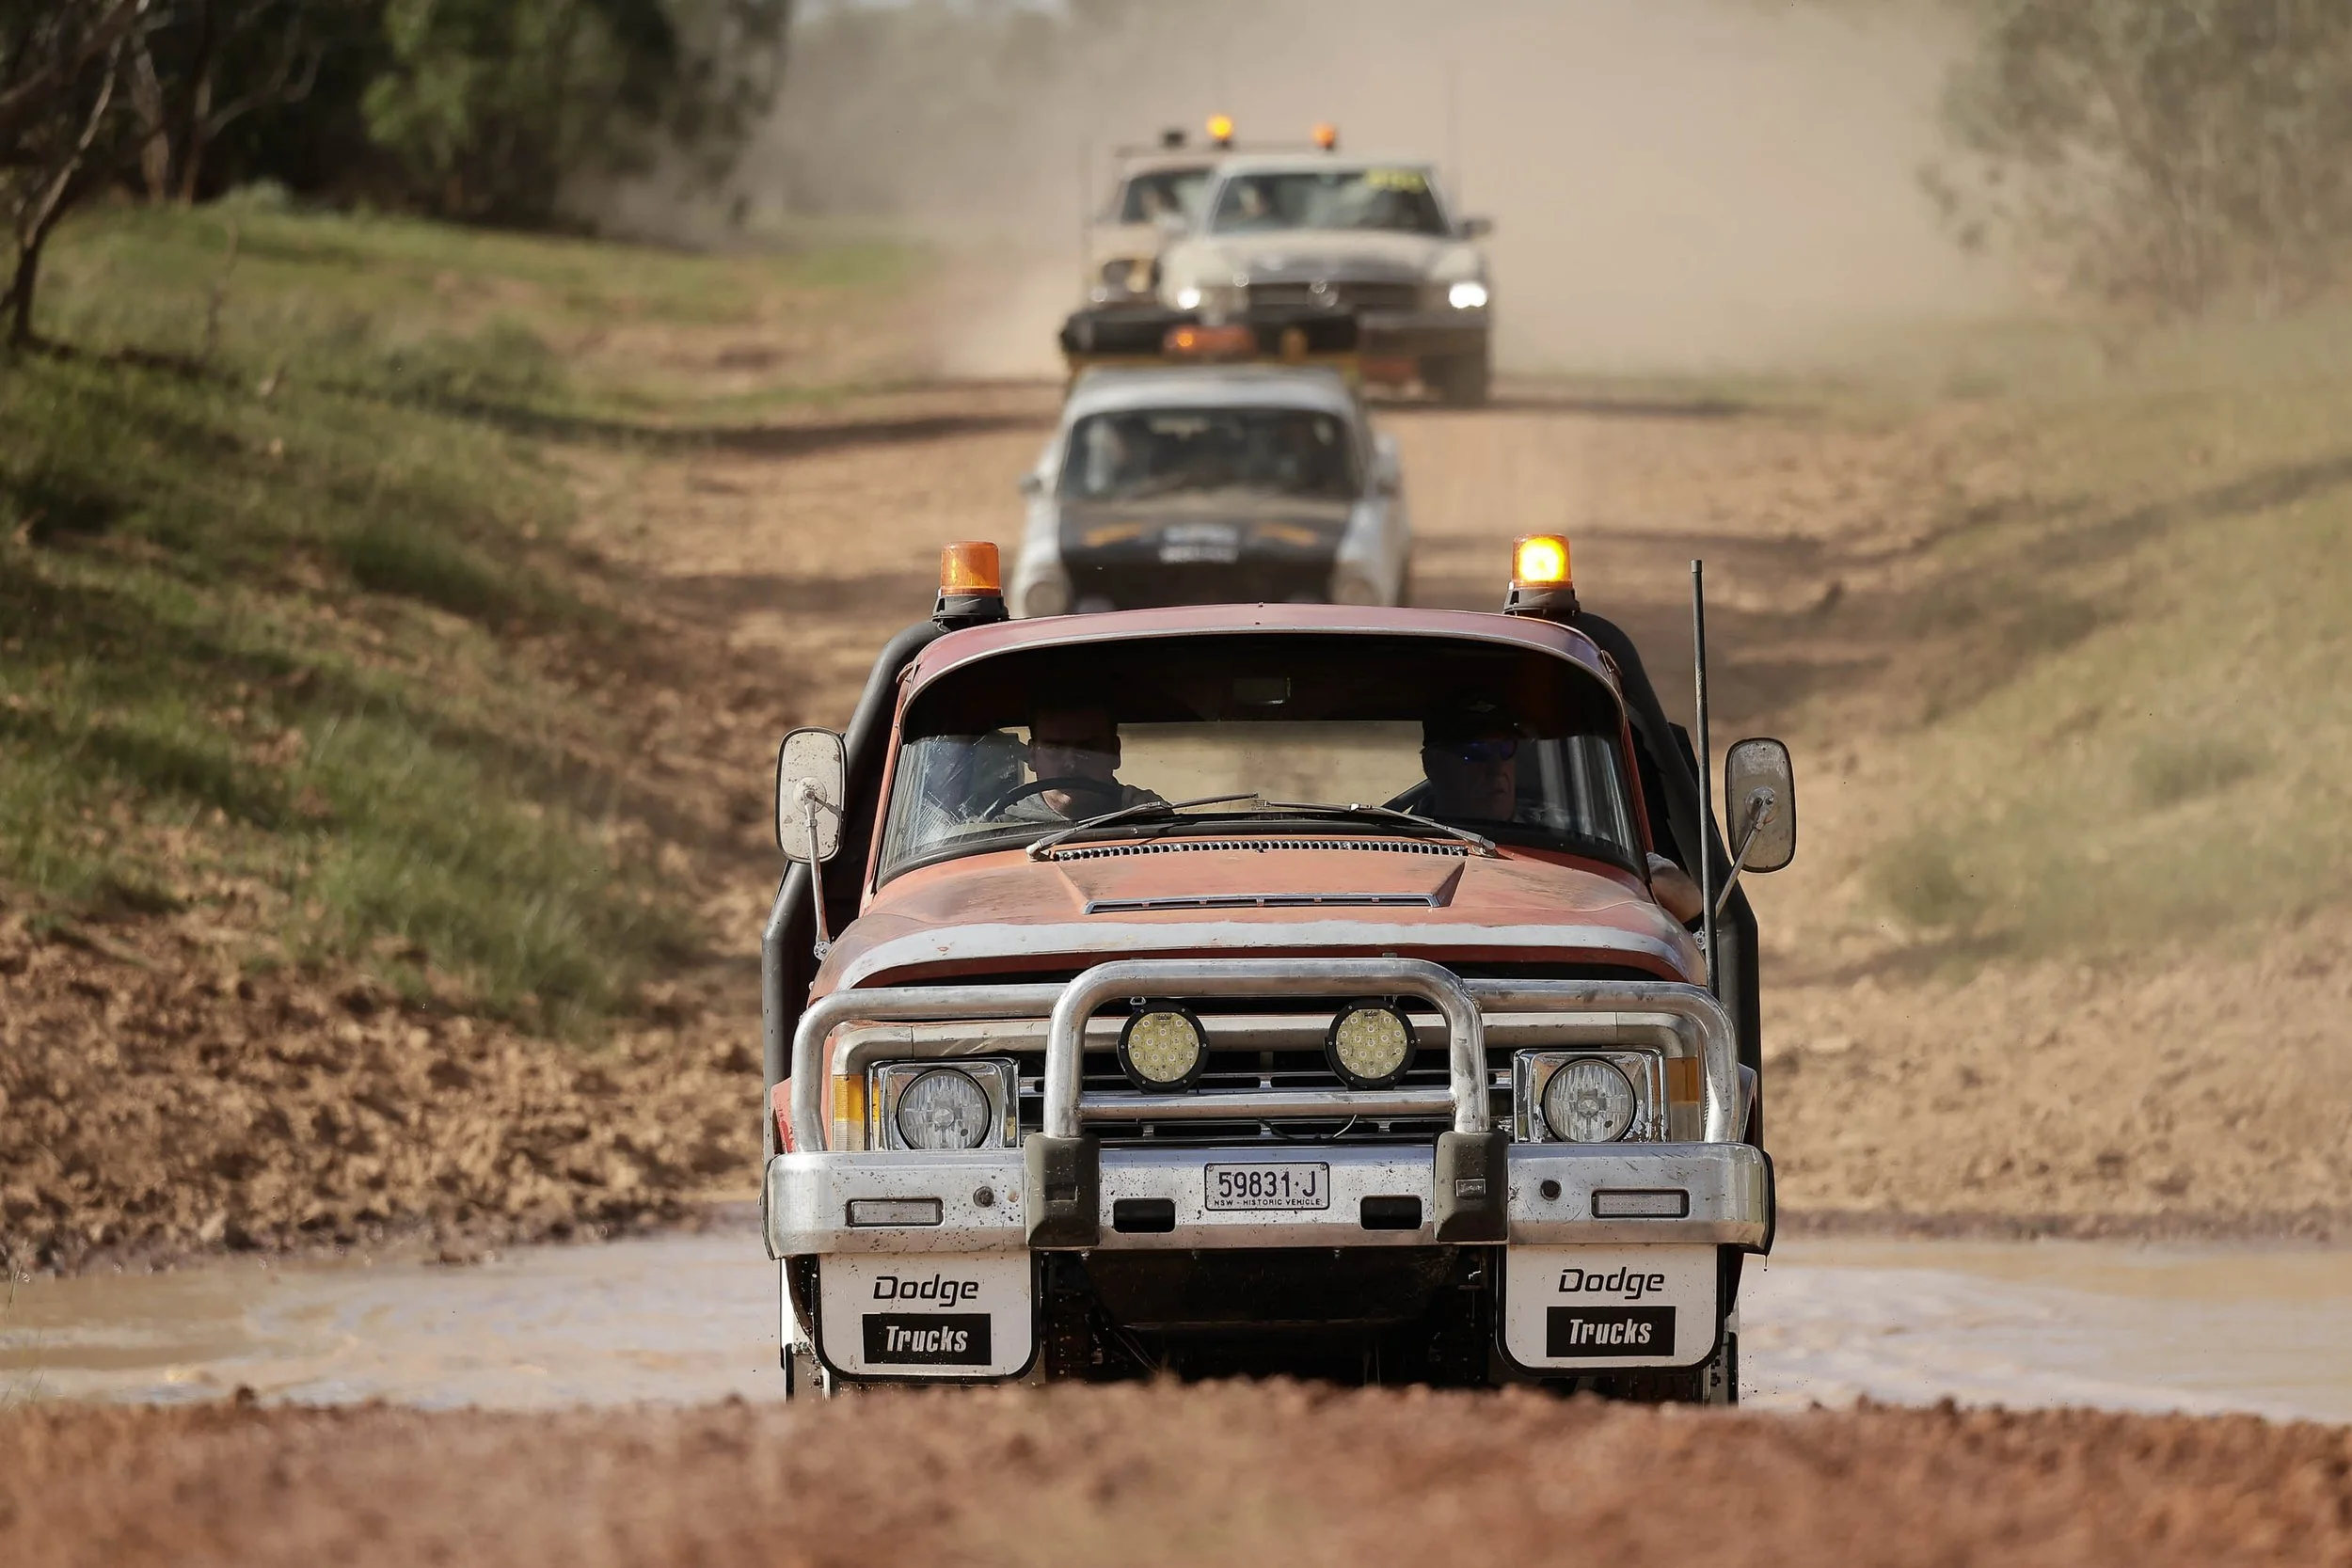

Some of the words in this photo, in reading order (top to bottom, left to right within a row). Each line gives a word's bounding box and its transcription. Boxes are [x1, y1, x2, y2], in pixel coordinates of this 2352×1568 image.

[873, 1274, 979, 1307] Dodge
[1558, 1266, 1665, 1300] Dodge
[886, 1325, 969, 1353] Trucks
[1569, 1319, 1652, 1345] Trucks
